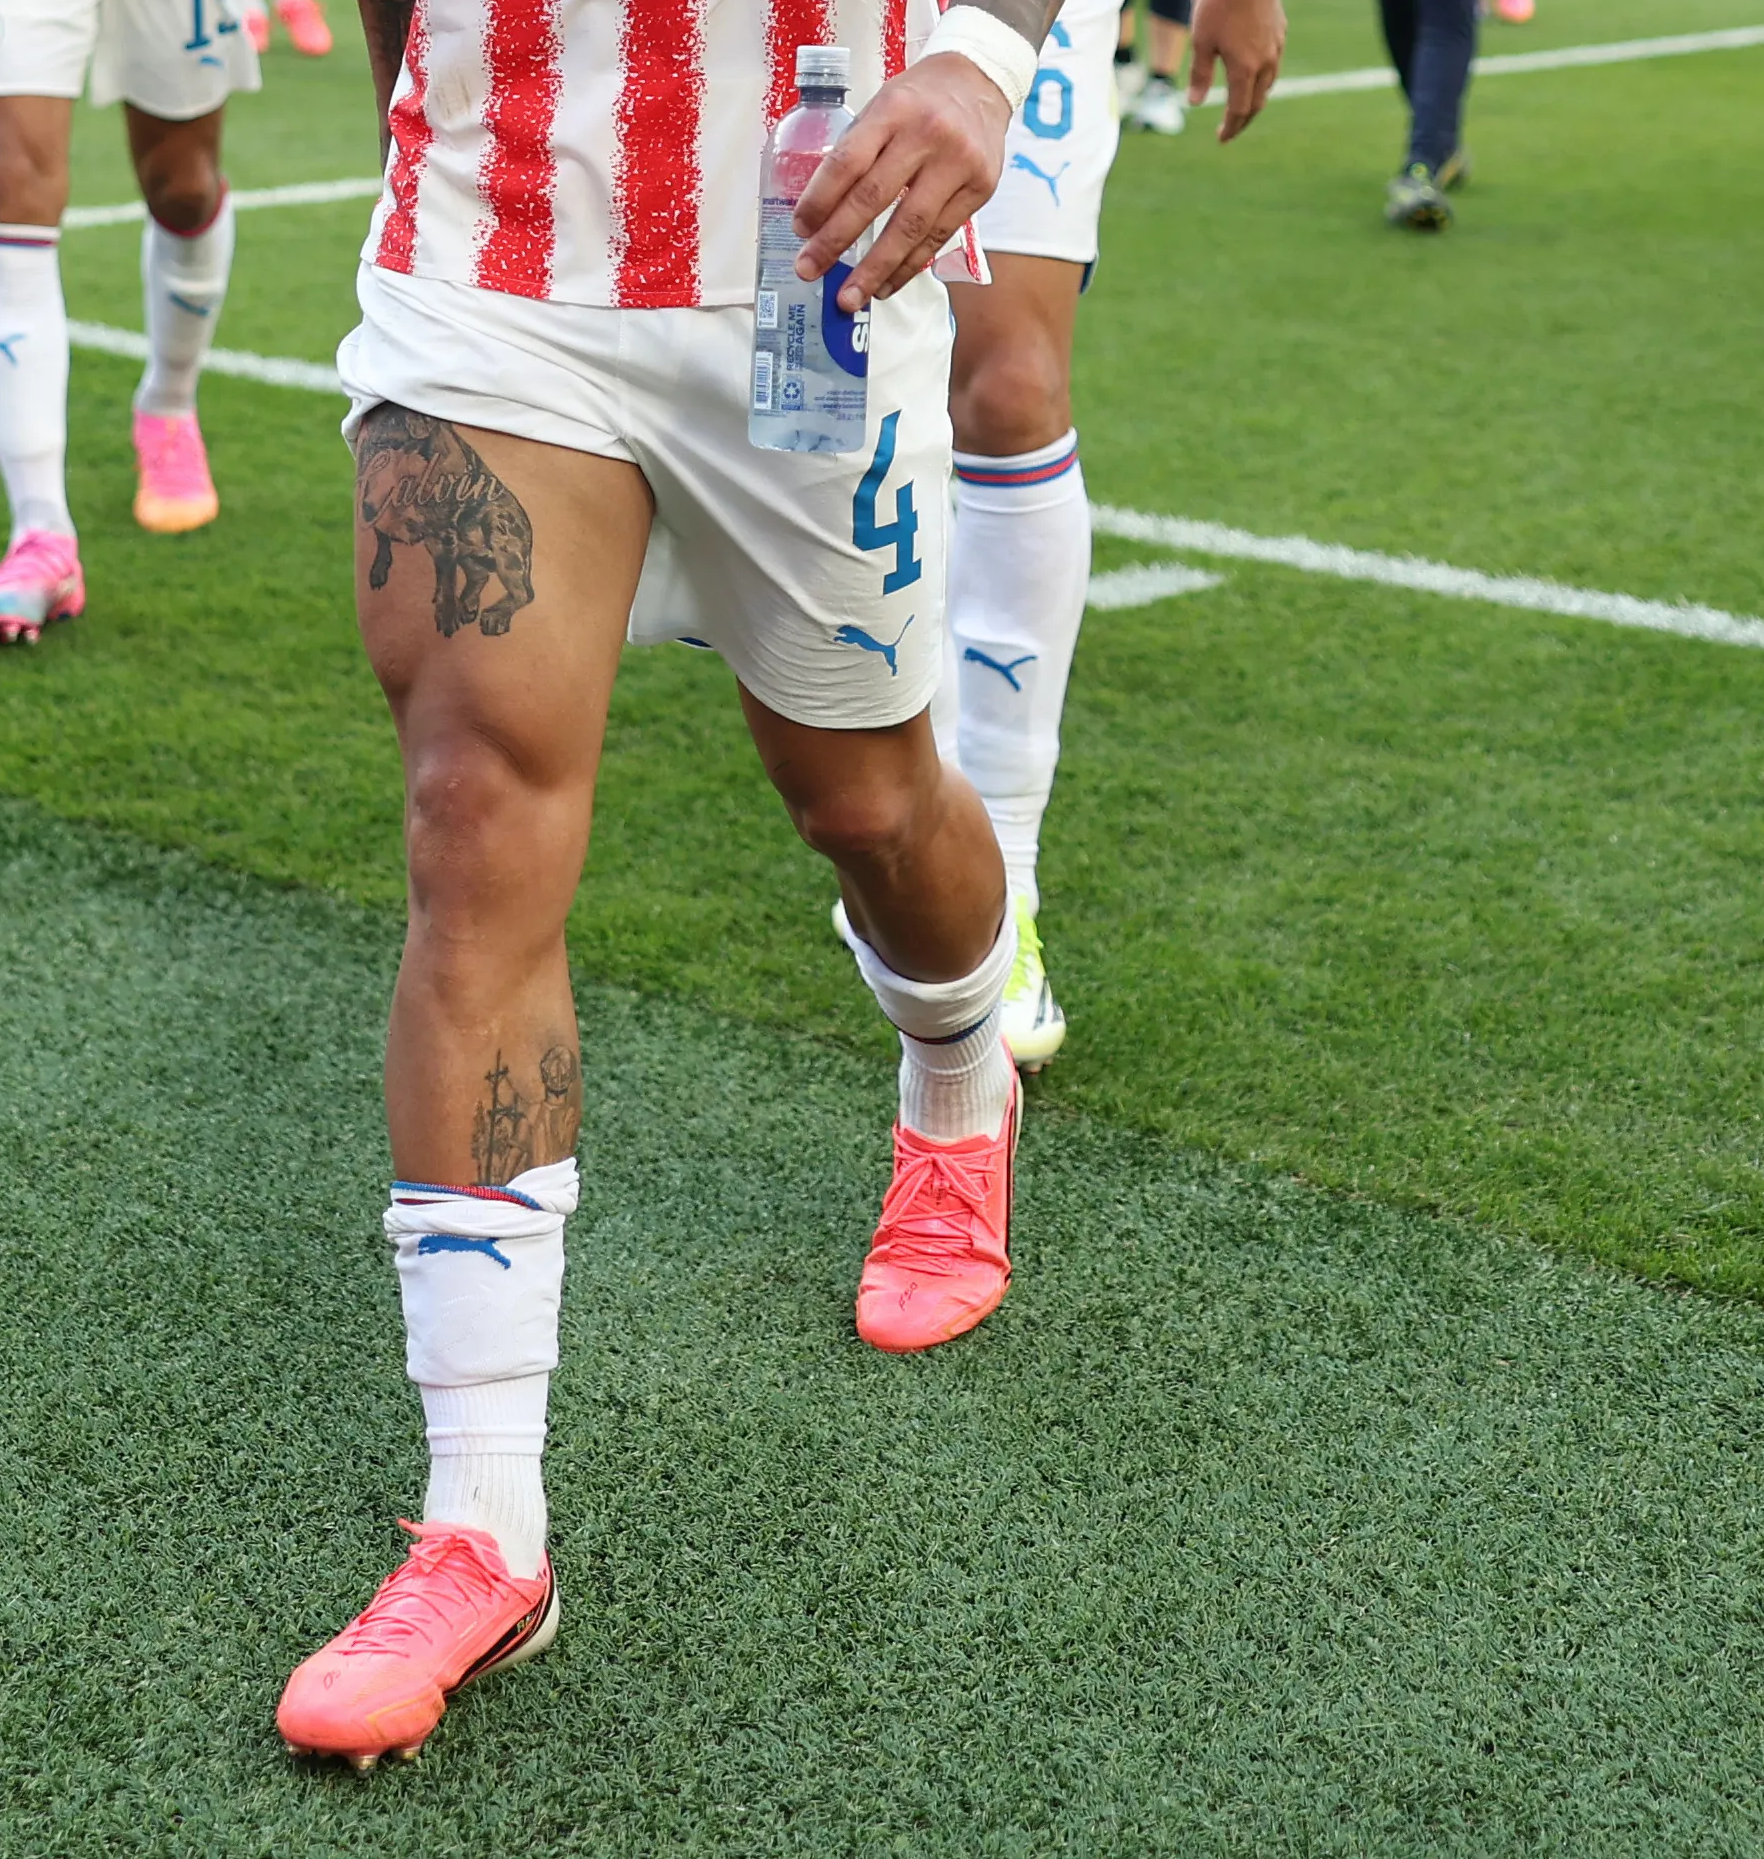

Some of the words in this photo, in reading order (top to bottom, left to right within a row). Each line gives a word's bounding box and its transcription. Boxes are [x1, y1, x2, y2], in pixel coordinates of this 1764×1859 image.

[788, 304, 796, 321] ME
[787, 323, 795, 371] RECYCLE
[357, 450, 505, 526] Calvin
[852, 408, 922, 597] 4
